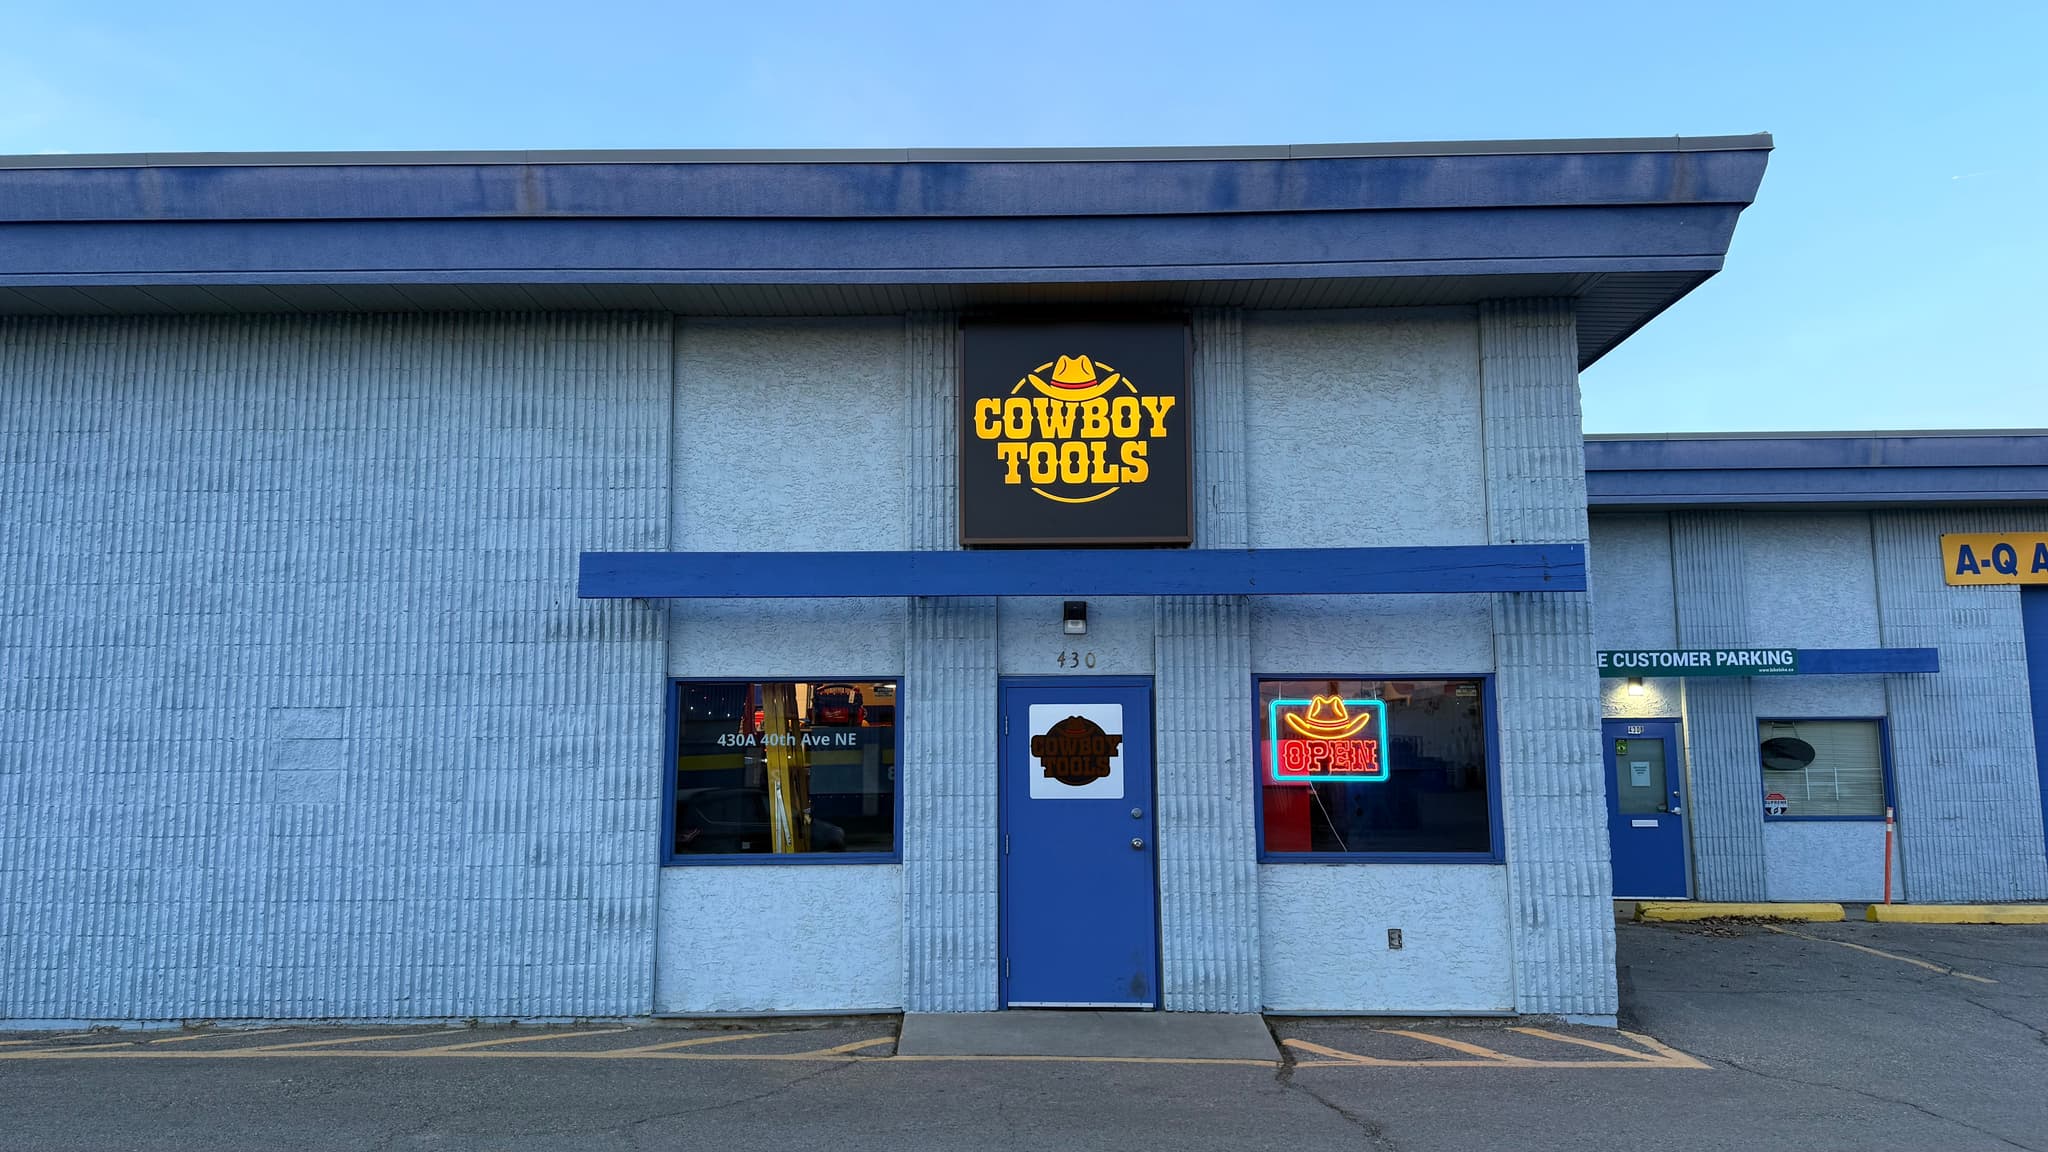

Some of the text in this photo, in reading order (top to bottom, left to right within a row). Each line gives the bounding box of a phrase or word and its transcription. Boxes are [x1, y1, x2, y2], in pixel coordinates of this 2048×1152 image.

[974, 396, 1176, 439] COWBOY
[997, 441, 1149, 484] TOOLS
[1956, 543, 2018, 576] A-Q
[1057, 650, 1097, 669] 430
[1598, 650, 1793, 668] E CUSTOMER PARKING
[717, 732, 857, 747] 430A 40th Ave NE
[1032, 735, 1121, 755] COWBOY
[1043, 755, 1110, 777] TOOLS
[1283, 740, 1378, 771] OPEN
